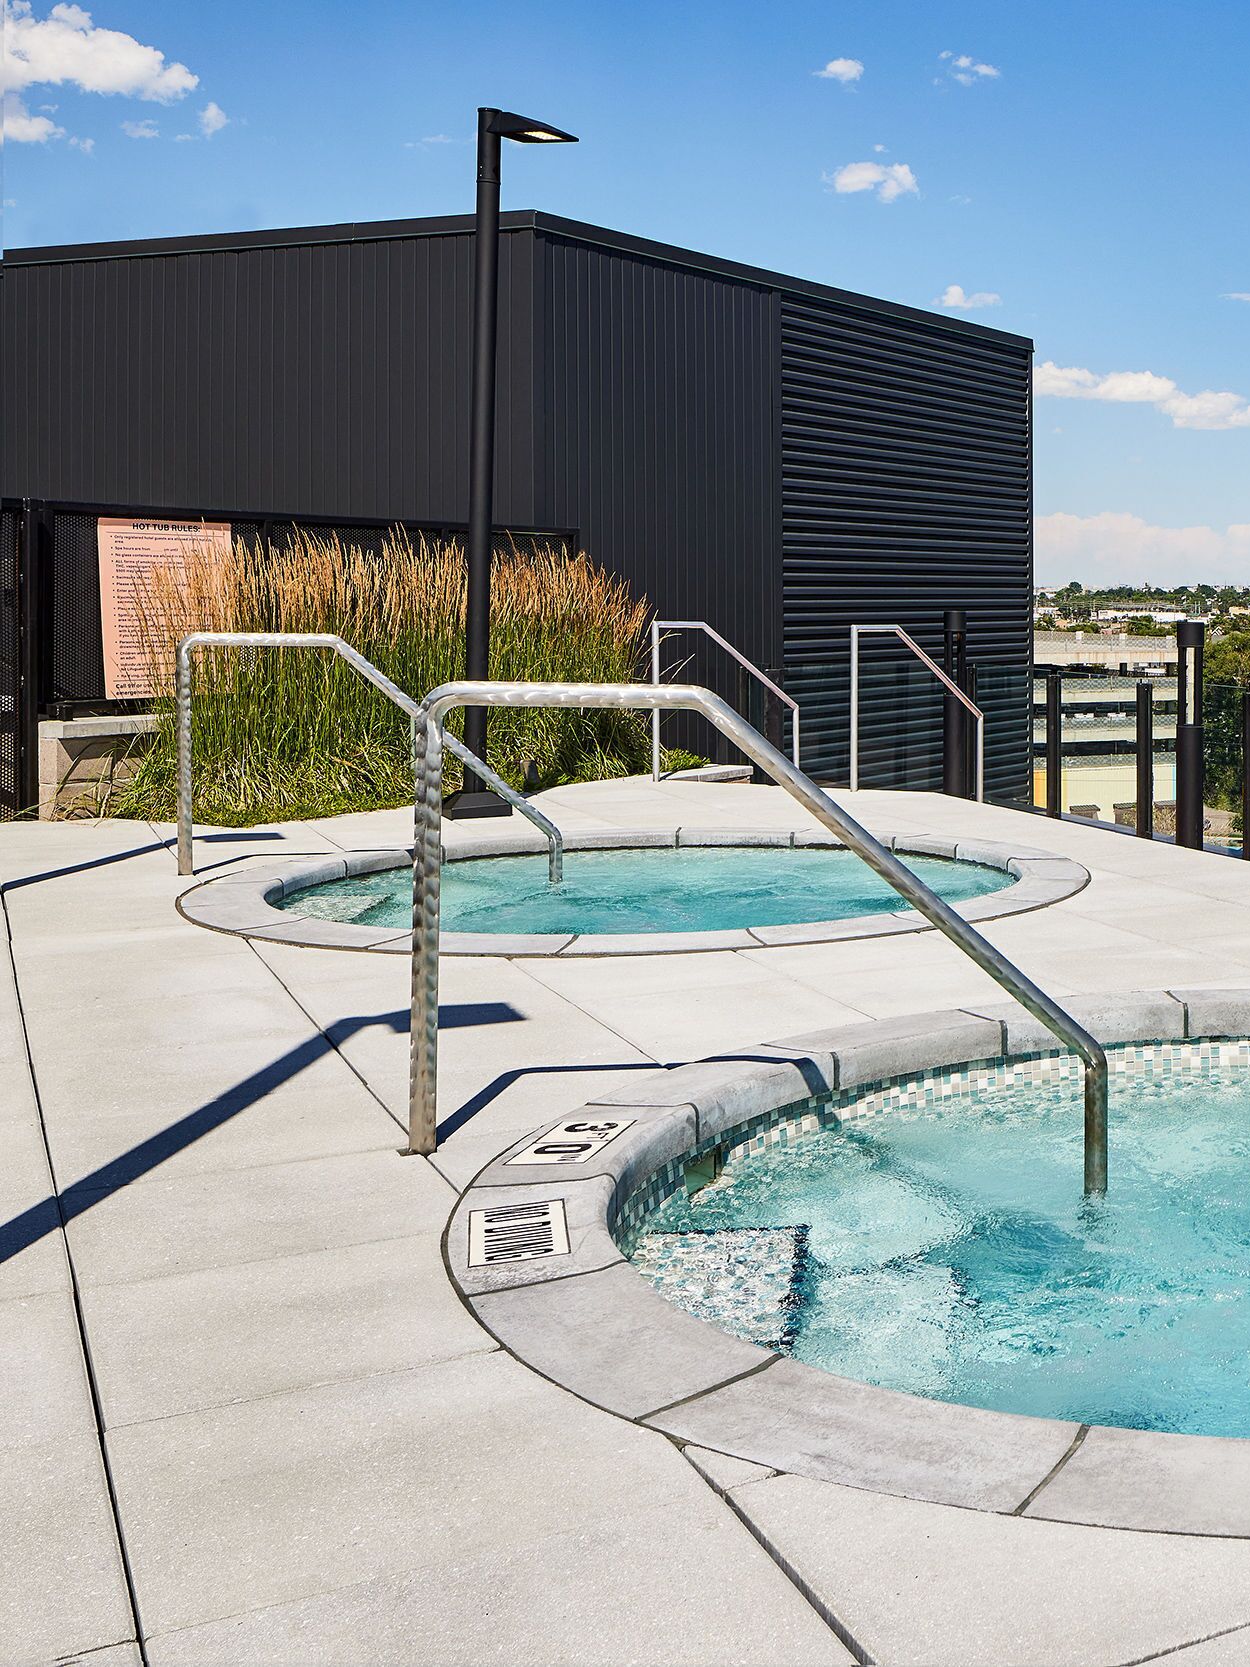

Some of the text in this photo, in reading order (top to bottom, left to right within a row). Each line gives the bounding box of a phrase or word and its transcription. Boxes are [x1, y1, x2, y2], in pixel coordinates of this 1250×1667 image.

[132, 522, 201, 533] HOT TUB RULES:
[564, 1122, 619, 1132] 3
[484, 1204, 555, 1262] NO DIVING
